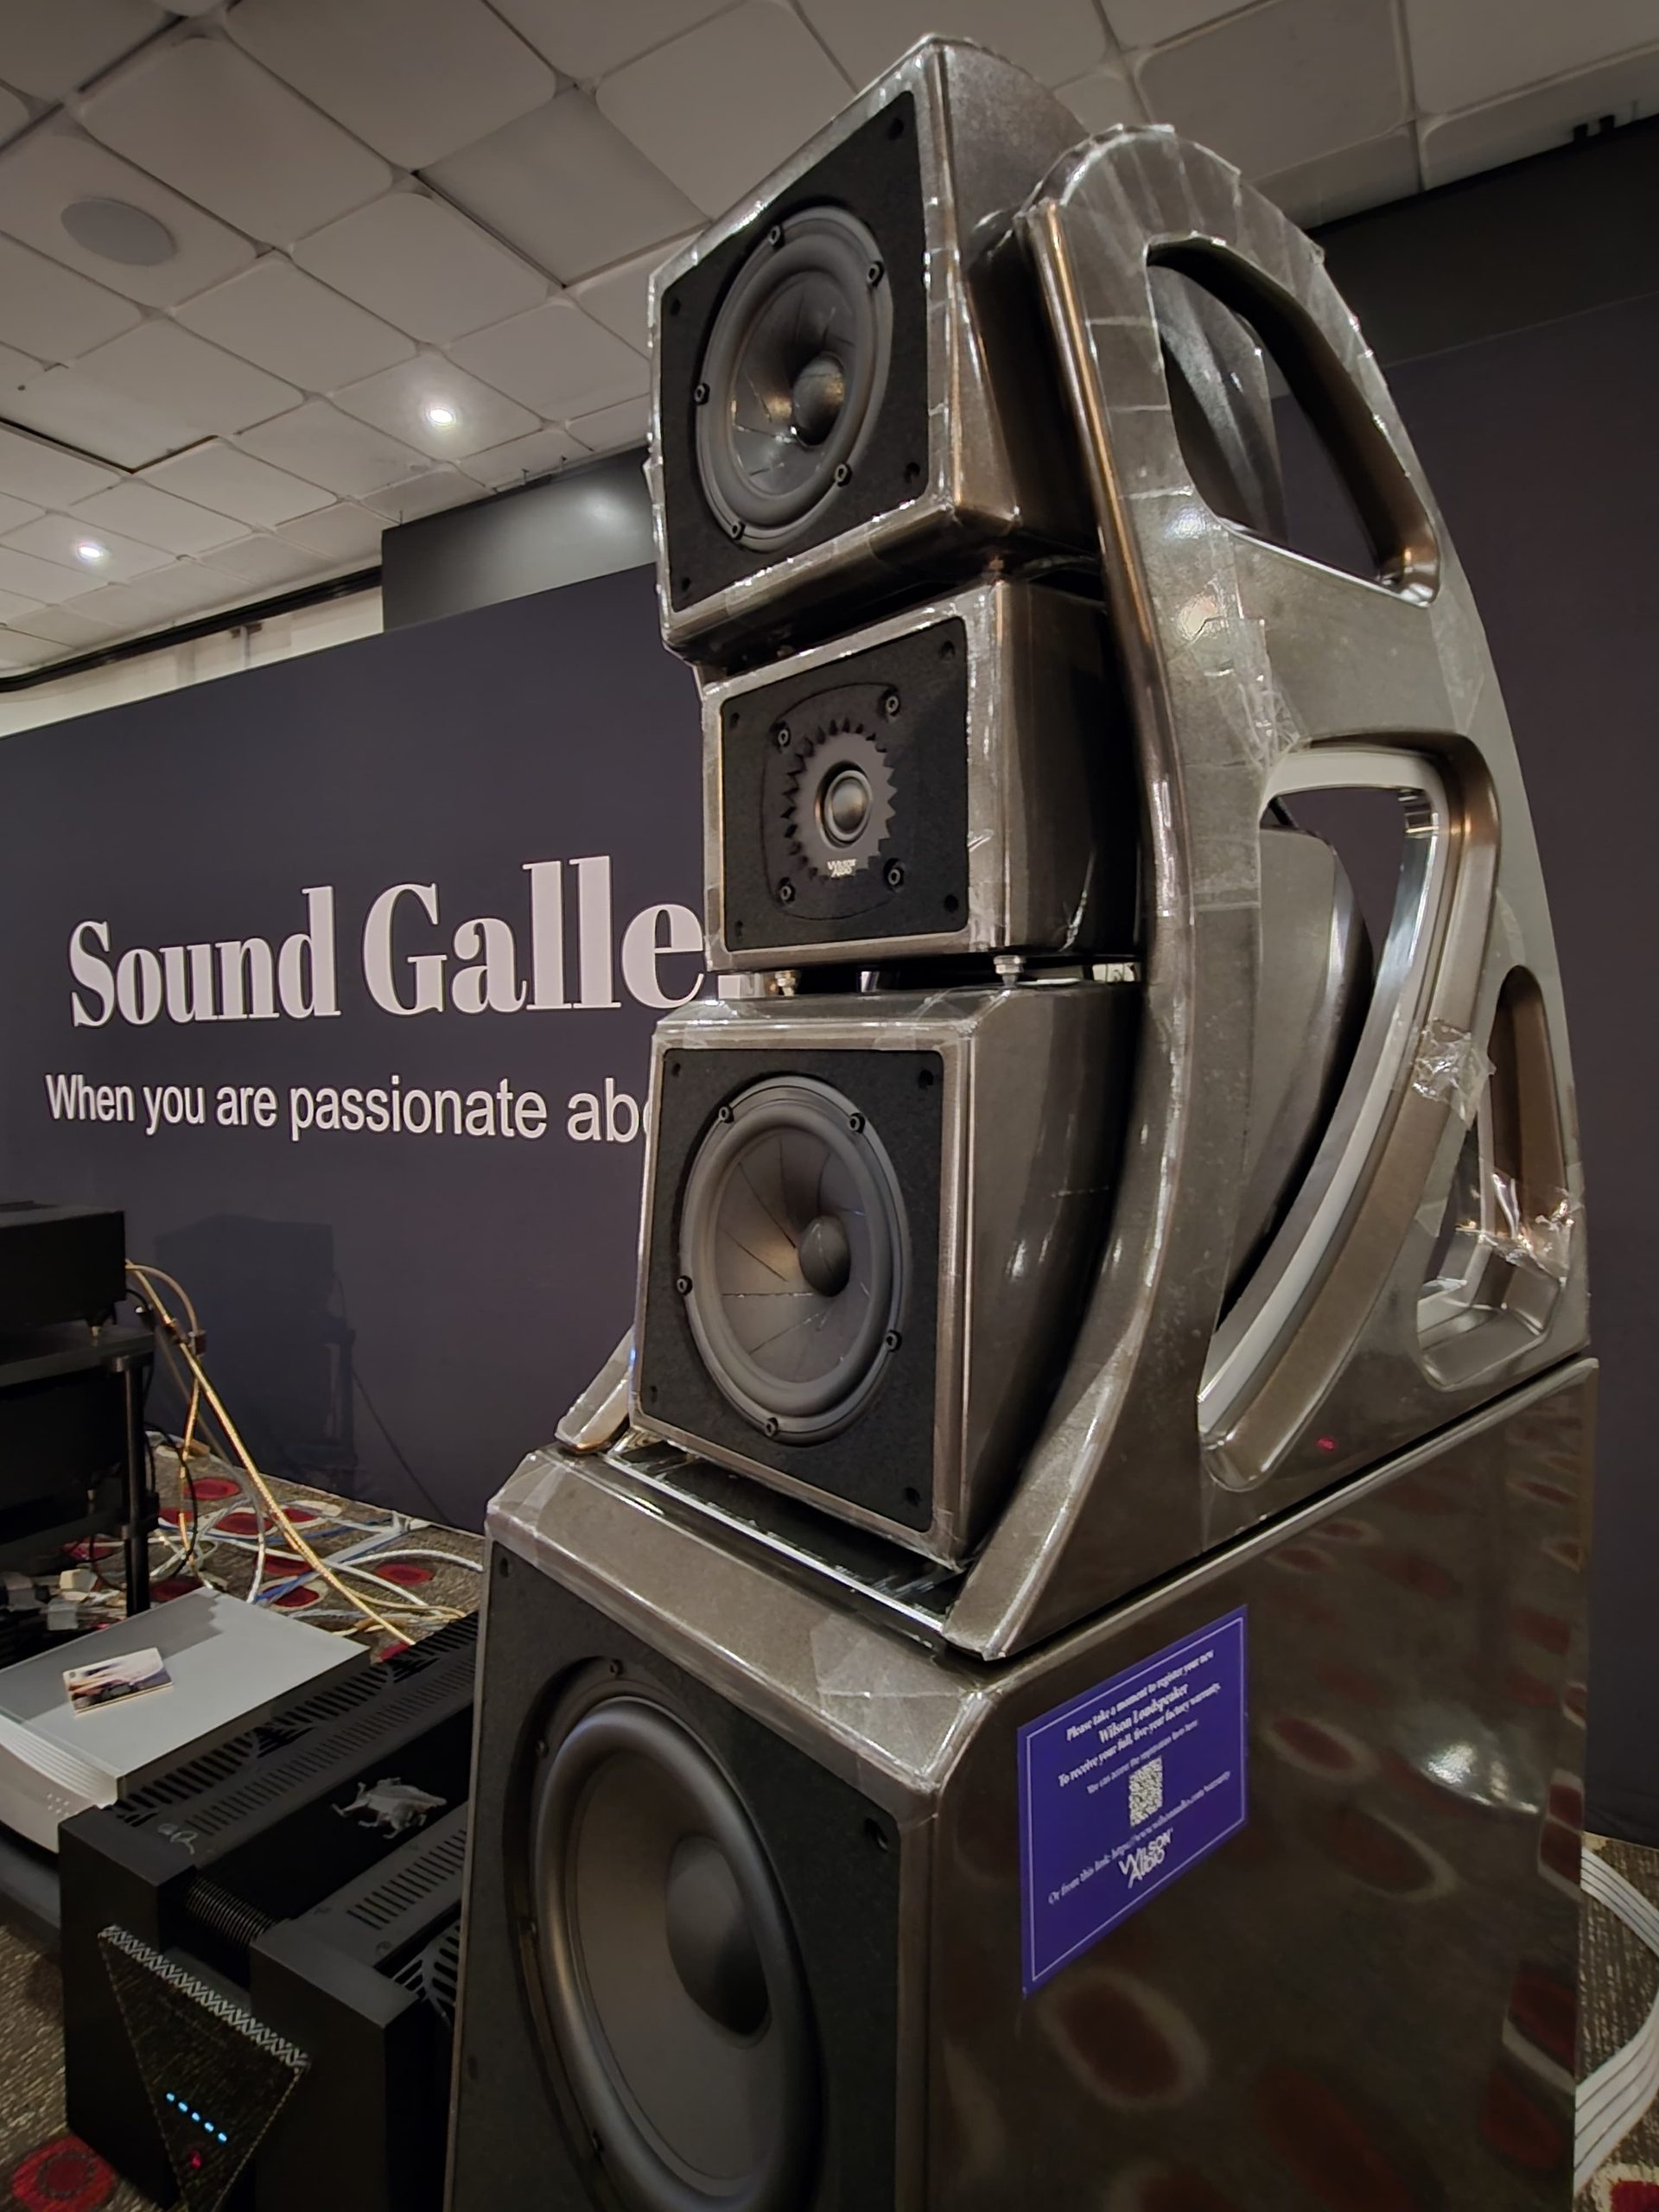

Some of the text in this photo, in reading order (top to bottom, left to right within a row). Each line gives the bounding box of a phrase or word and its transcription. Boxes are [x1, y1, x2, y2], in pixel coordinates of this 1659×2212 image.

[69, 886, 340, 1028] Sound
[46, 1074, 135, 1122] When
[144, 1084, 206, 1137] you
[217, 1084, 277, 1127] are
[290, 1075, 548, 1141] passionate
[1066, 1719, 1092, 1741] Please
[1092, 1709, 1109, 1726] take
[1098, 1683, 1188, 1743] Wilson Loudspeaker
[1058, 1773, 1070, 1788] To
[1070, 1756, 1098, 1781] receive
